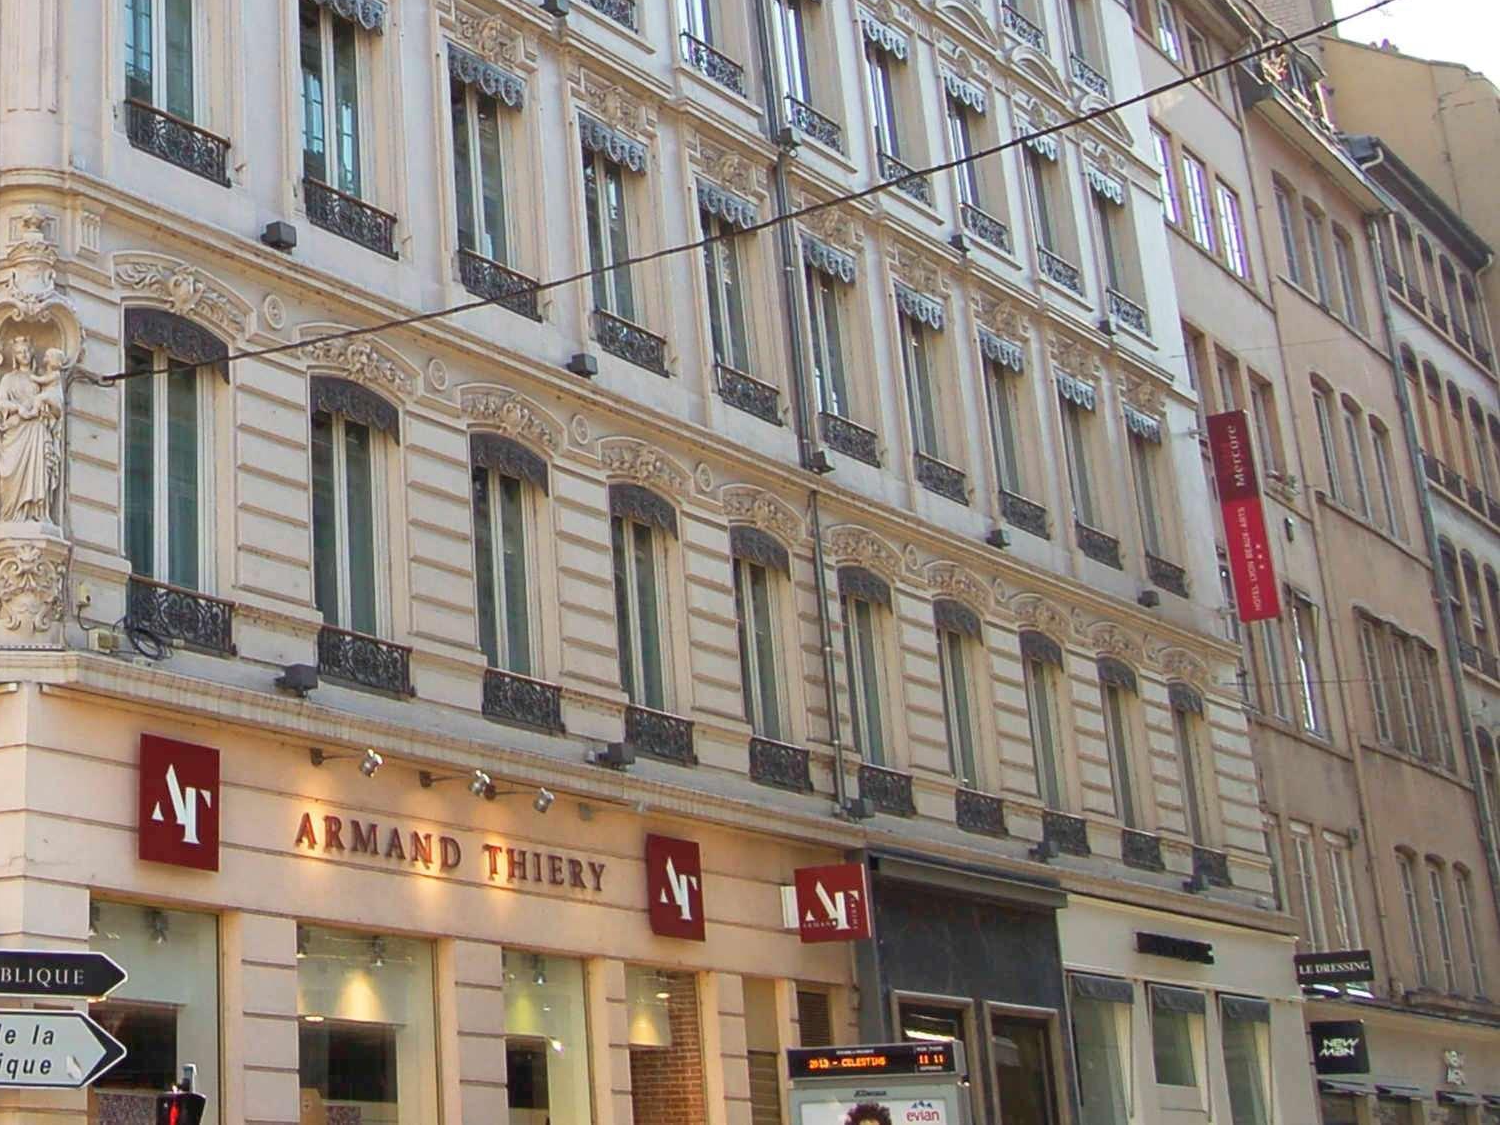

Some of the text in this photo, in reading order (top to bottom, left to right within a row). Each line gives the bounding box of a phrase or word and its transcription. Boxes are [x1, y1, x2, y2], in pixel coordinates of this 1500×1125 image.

[1227, 425, 1245, 487] Mercure
[294, 812, 606, 892] ARMAND THIERY
[32, 1025, 55, 1045] la
[906, 1109, 940, 1122] evian
